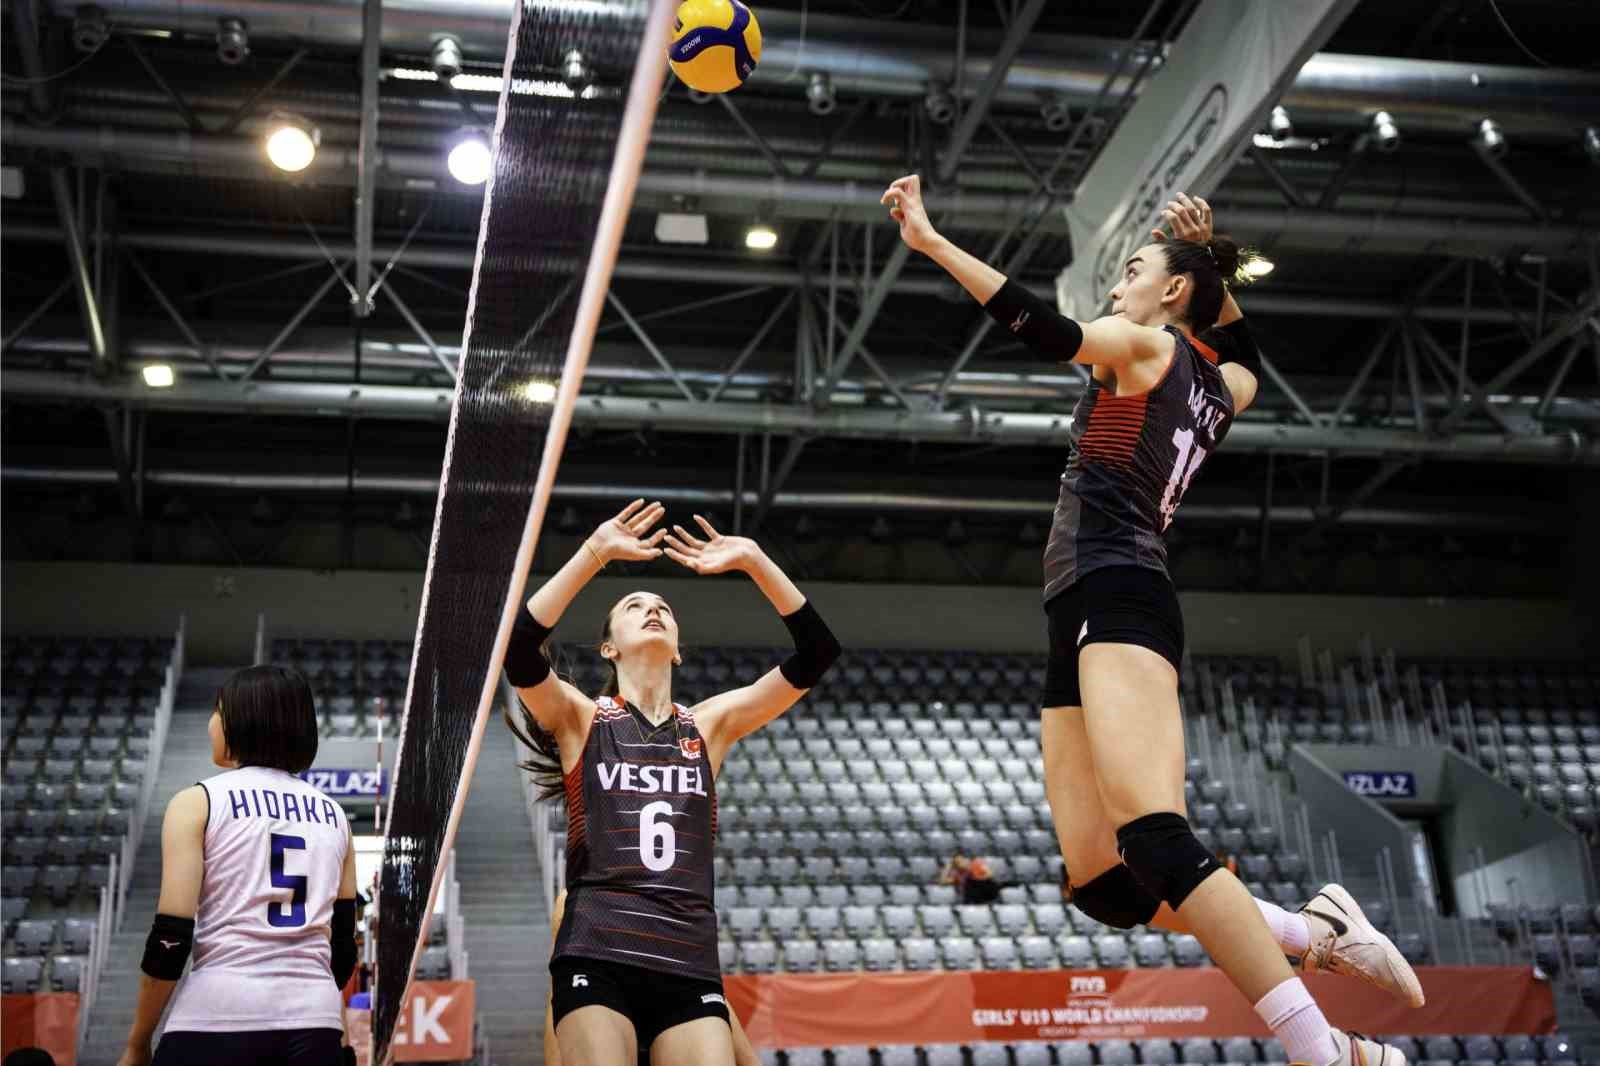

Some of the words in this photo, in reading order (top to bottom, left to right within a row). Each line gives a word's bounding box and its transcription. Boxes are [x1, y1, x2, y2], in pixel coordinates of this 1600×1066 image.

[307, 770, 380, 795] IZLAZ
[596, 762, 707, 797] VESTEL
[228, 788, 338, 828] HIDAKA
[639, 800, 676, 872] 6
[267, 832, 307, 928] 5
[1020, 1008, 1050, 1025] U19
[1052, 1007, 1102, 1024] WORLD
[1104, 1006, 1208, 1023] CHAMPIONSHIP
